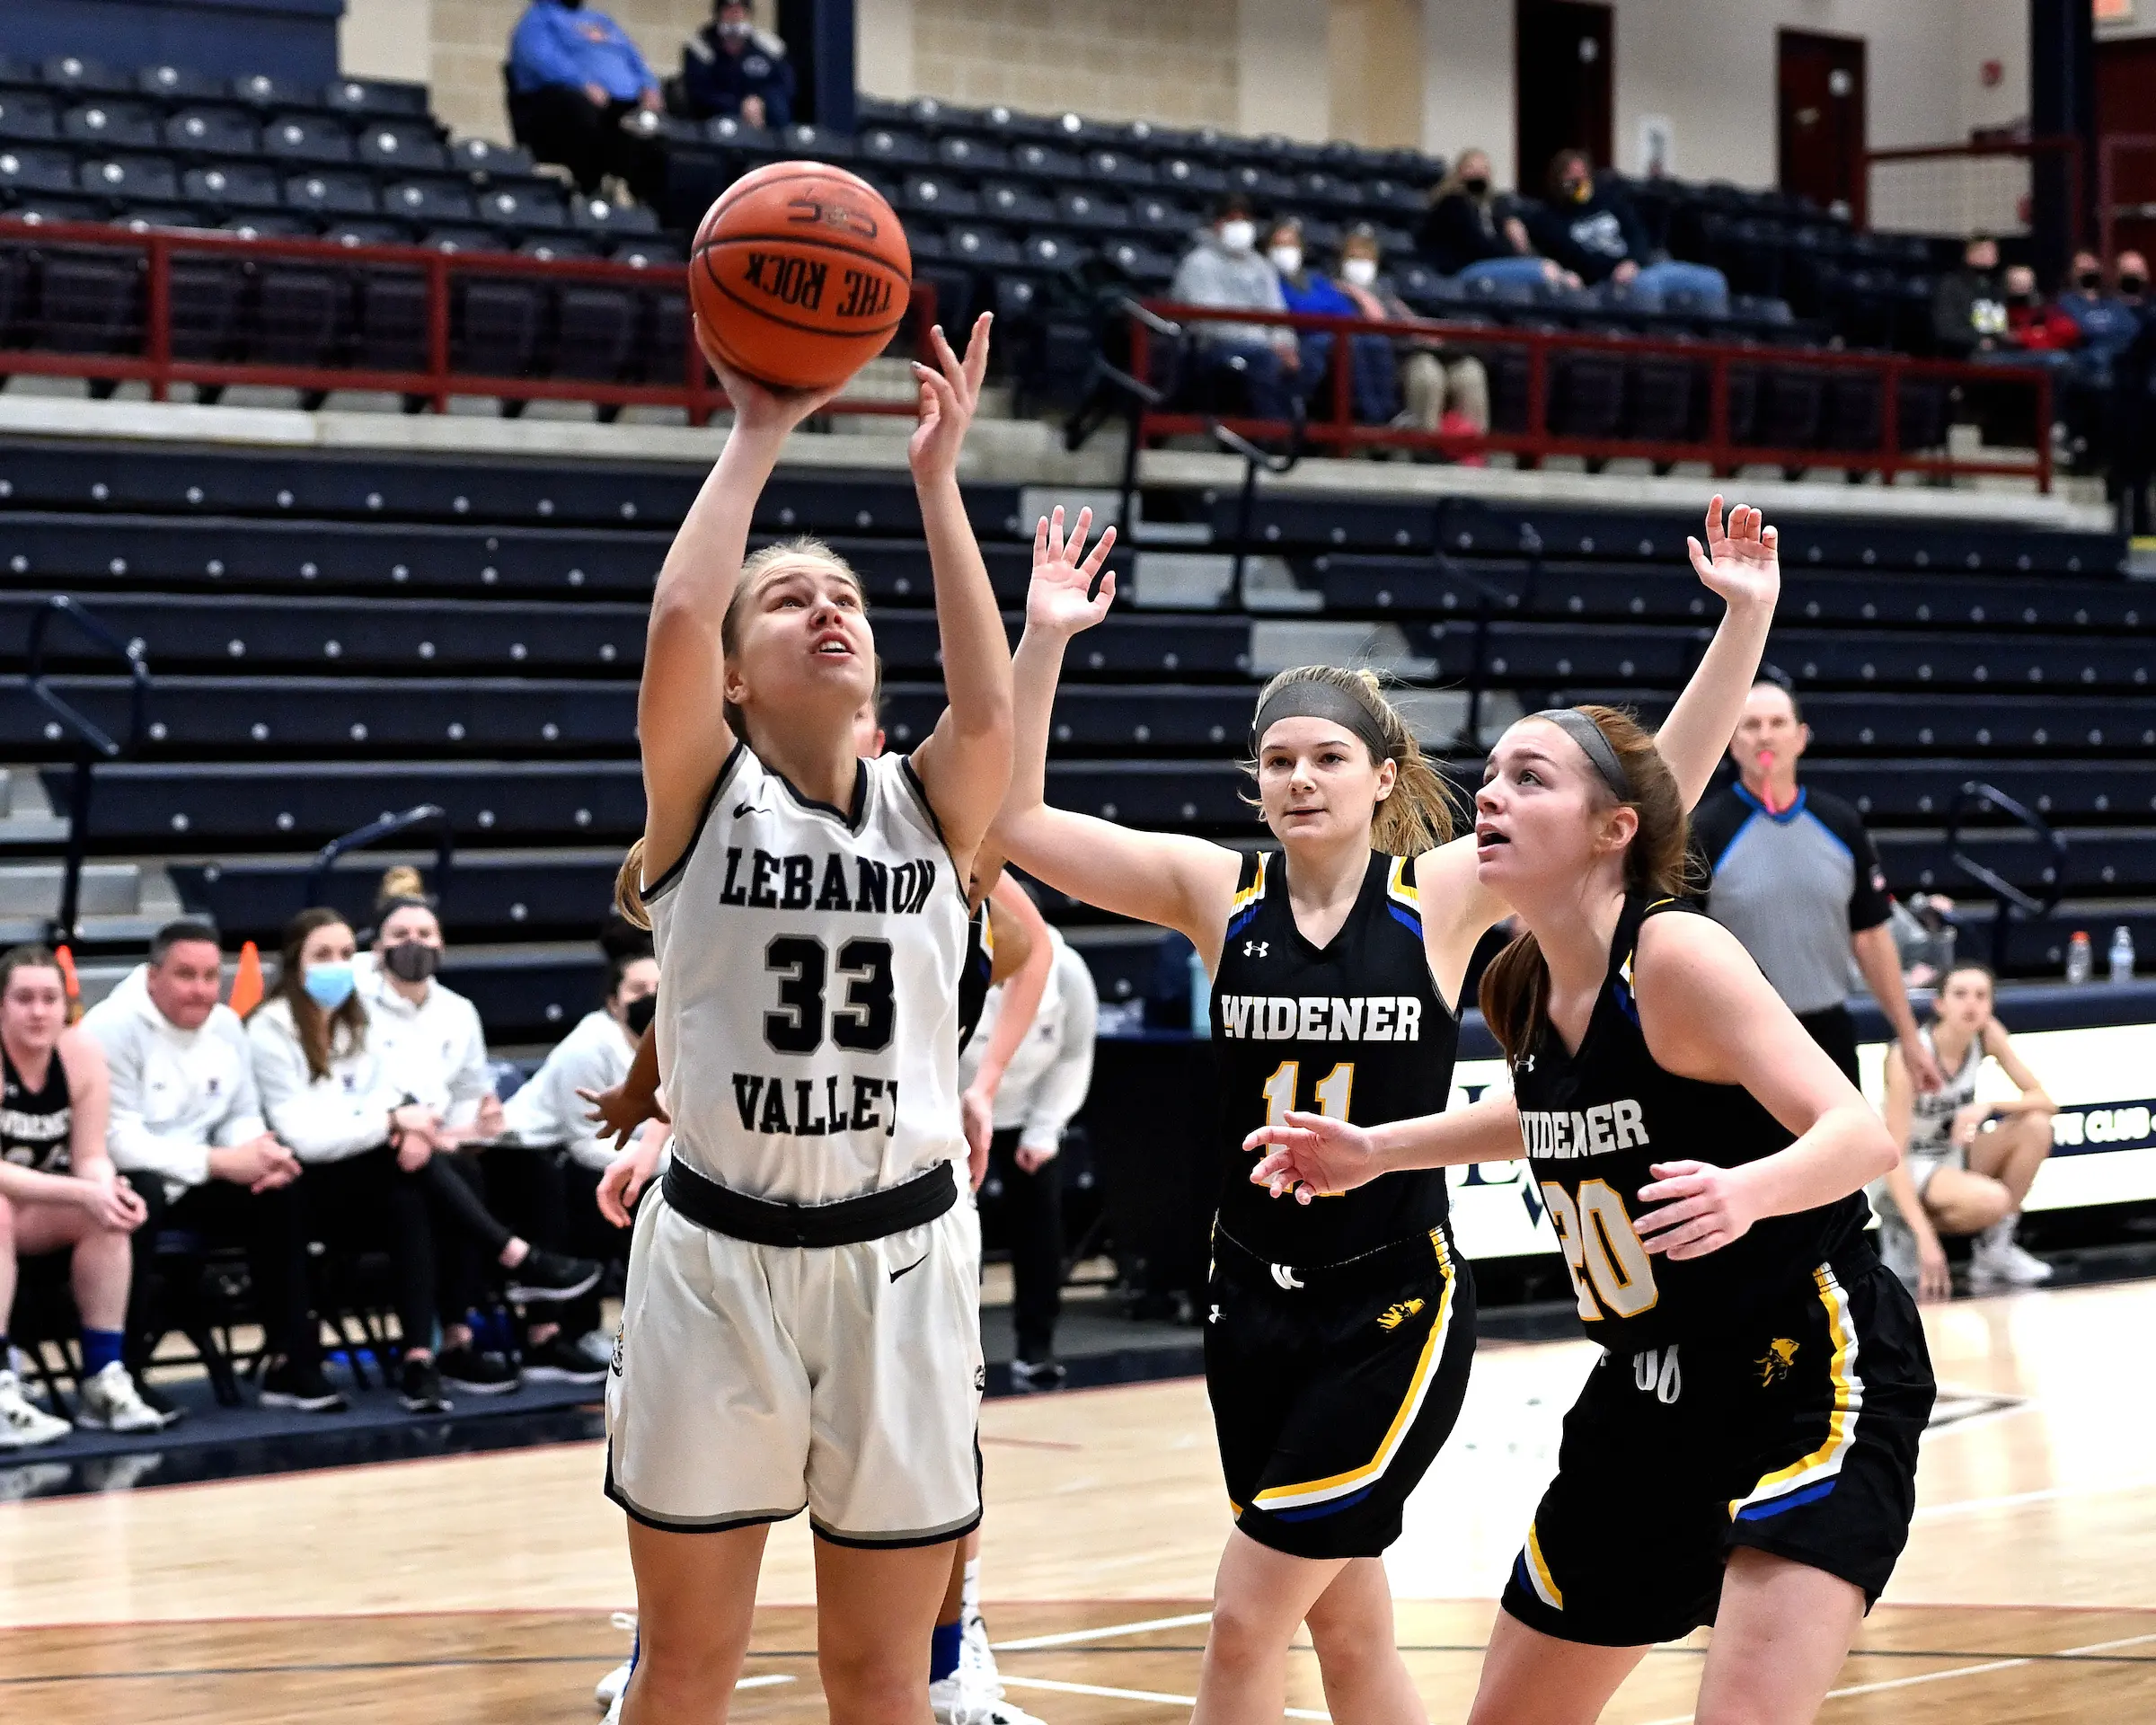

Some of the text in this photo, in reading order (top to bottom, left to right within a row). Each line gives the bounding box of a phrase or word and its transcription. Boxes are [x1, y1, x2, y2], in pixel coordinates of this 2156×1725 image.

[744, 251, 892, 317] THE ROCK
[719, 846, 938, 915] LEBANON
[763, 932, 897, 1057] 33
[1220, 995, 1422, 1041] WIDENER
[2085, 1106, 2151, 1144] CLUB
[1541, 1178, 1659, 1322] 20
